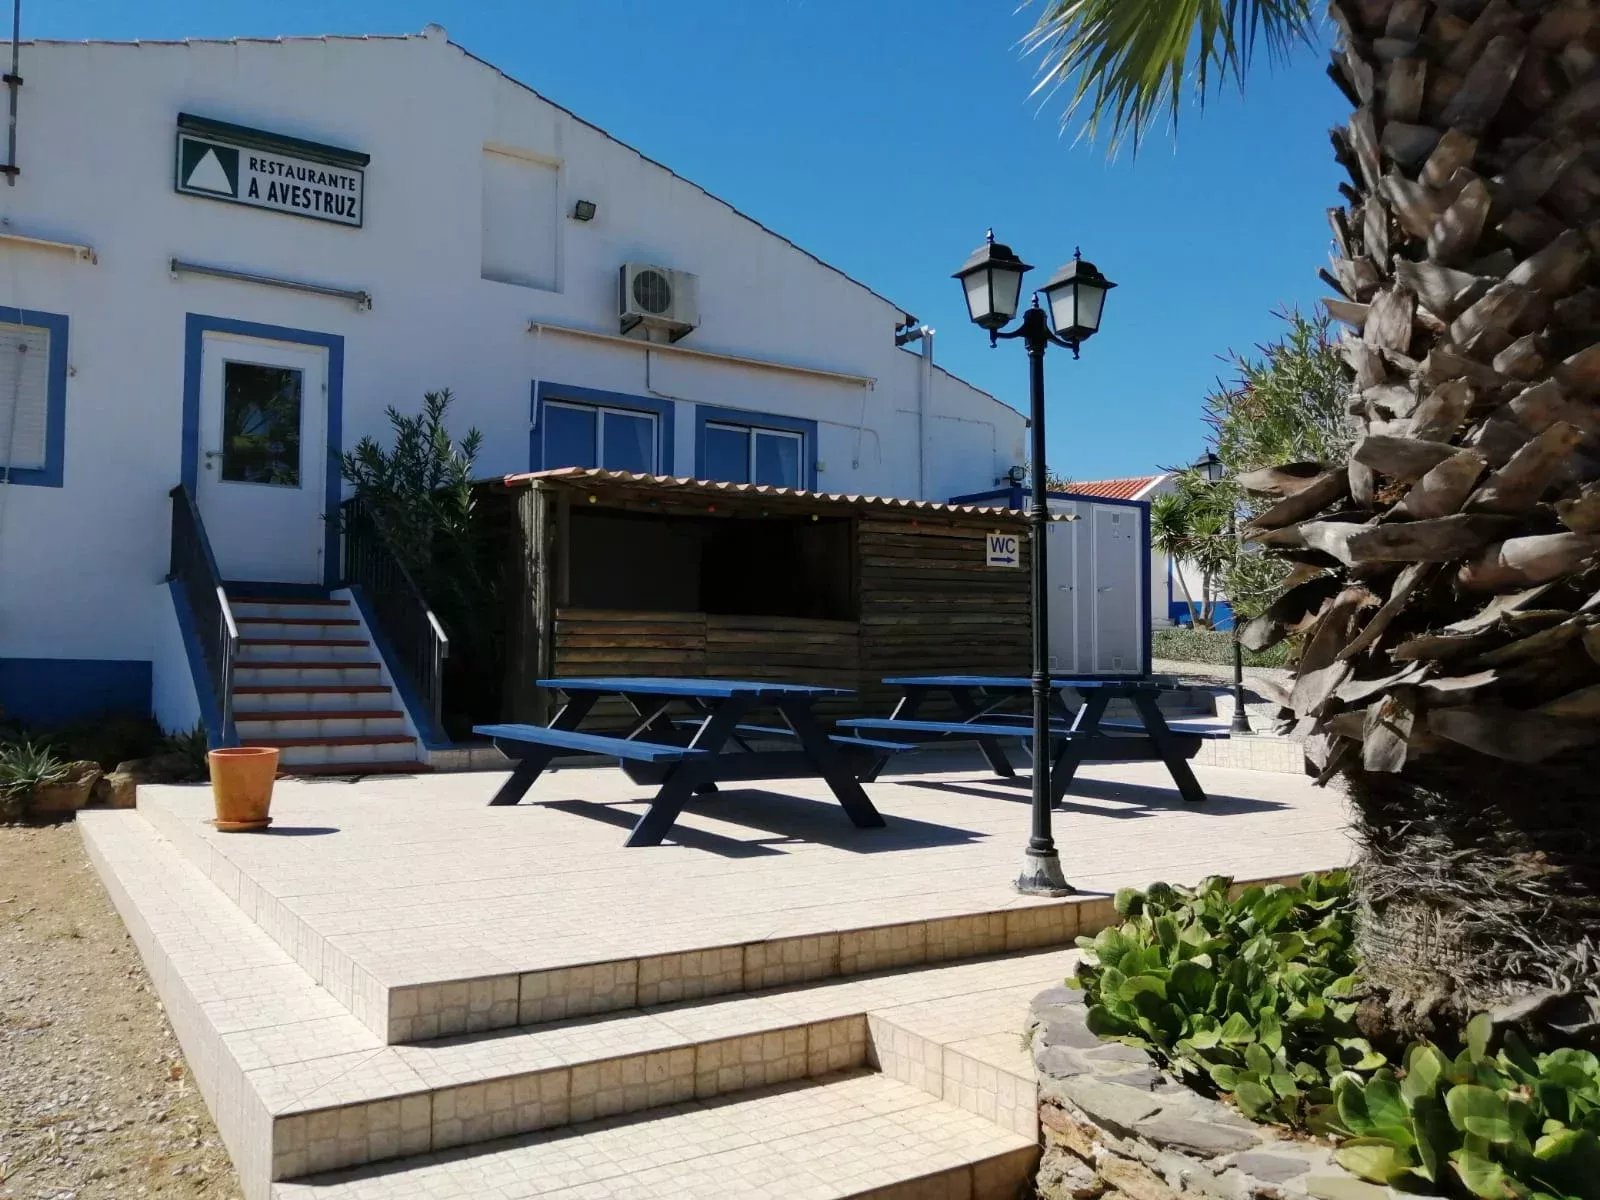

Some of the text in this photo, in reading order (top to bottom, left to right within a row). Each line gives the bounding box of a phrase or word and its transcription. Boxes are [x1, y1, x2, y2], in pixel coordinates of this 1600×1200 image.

[249, 157, 356, 192] RESTAURANTE
[248, 177, 356, 218] A AVESTRUZ
[991, 536, 1016, 554] WC
